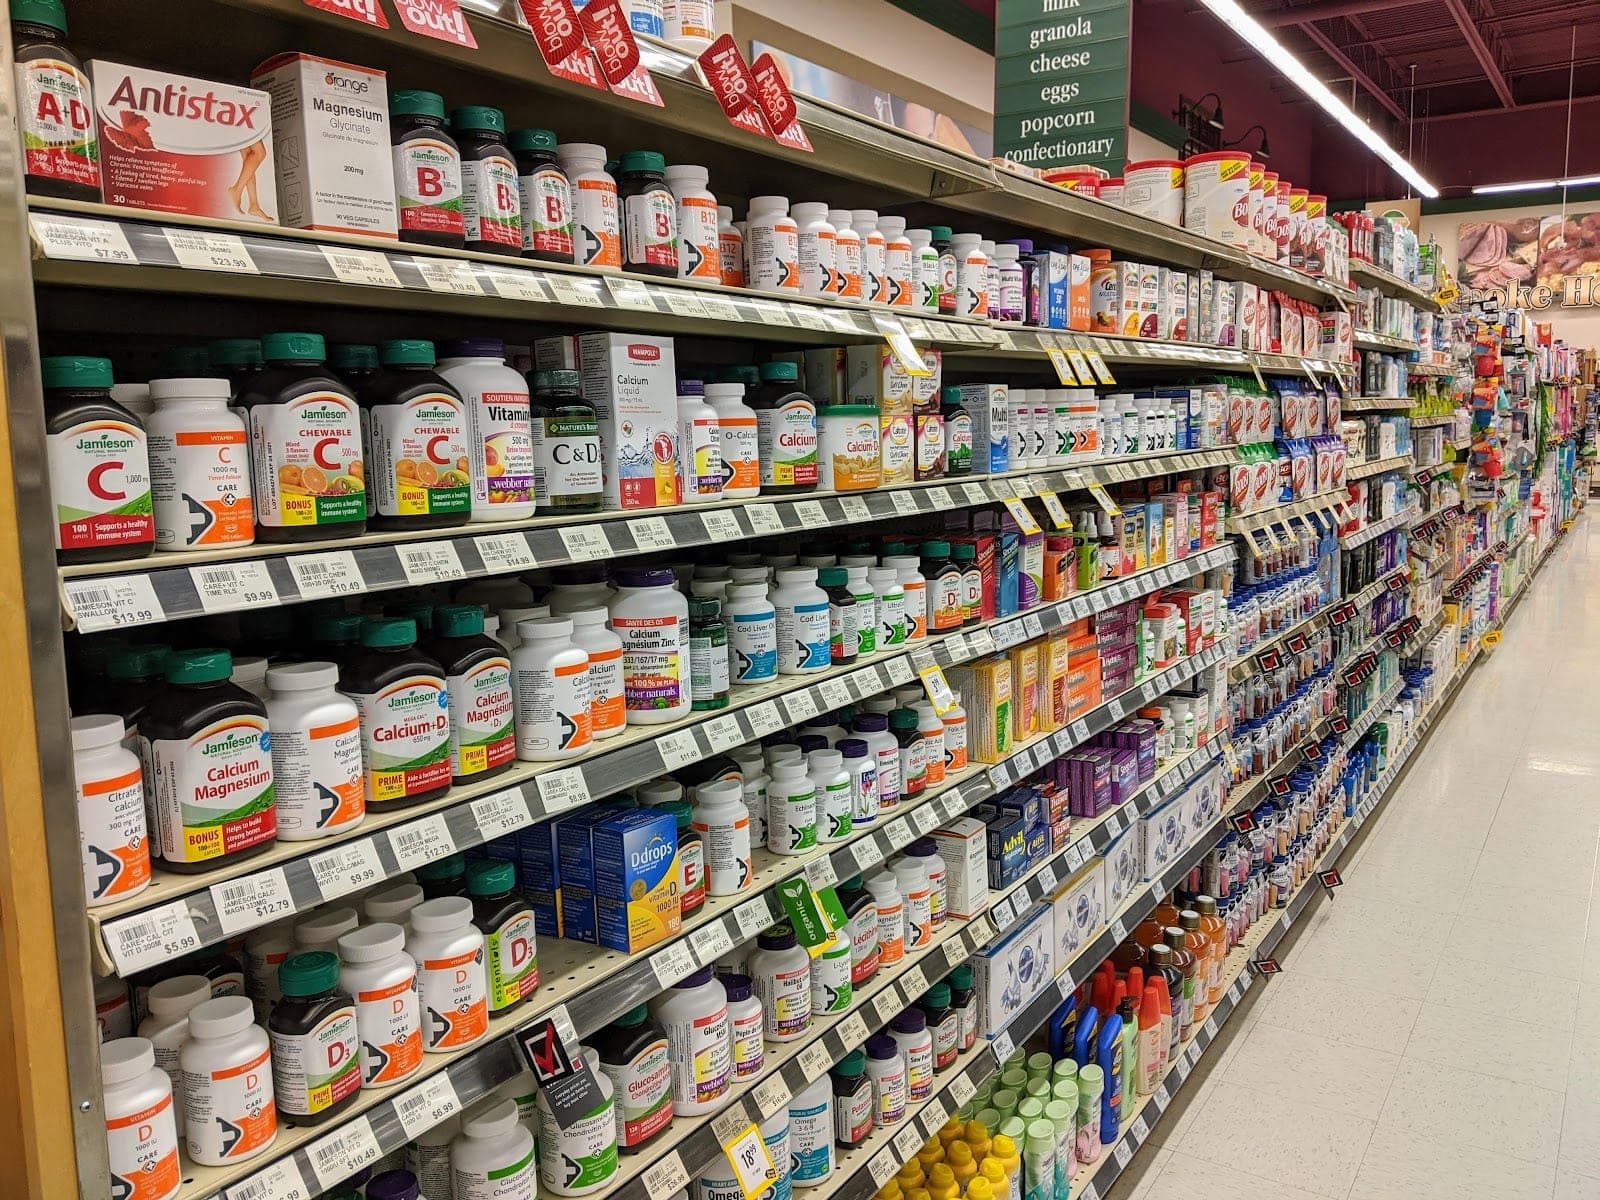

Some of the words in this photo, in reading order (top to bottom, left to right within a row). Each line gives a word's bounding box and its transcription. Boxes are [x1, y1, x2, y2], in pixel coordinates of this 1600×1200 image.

[407, 8, 466, 43] out!
[535, 5, 562, 53] blow
[592, 3, 628, 60] out!
[1030, 17, 1092, 49] granola
[595, 26, 622, 75] blow
[1030, 52, 1090, 74] cheese
[712, 47, 748, 95] out!
[716, 70, 740, 110] blow
[756, 66, 789, 112] out!
[1041, 82, 1080, 104] eggs
[108, 75, 256, 130] Antistax
[762, 88, 782, 126] blow
[313, 98, 383, 124] Magnesium
[330, 118, 371, 135] Glycinate
[1020, 110, 1095, 138] popcorn
[1004, 138, 1114, 162] confectionary
[411, 152, 450, 162] Jamieson
[113, 194, 126, 204] 30
[44, 232, 86, 242] JAMIESON
[50, 238, 72, 246] PLUS
[95, 248, 129, 260] $7.99
[211, 256, 246, 268] $23.99
[633, 349, 657, 357] WAMPOLE
[618, 374, 649, 386] Calcium
[618, 386, 640, 395] Liquid
[486, 394, 512, 402] SOUTIEN
[301, 408, 346, 420] Jamieson
[416, 410, 456, 419] Jamieson
[992, 408, 1008, 422] Multi
[299, 429, 352, 437] CHEWABLE
[414, 427, 460, 435] CHEWABLE
[75, 438, 134, 450] Jamieson
[210, 434, 234, 442] VITAMIN
[780, 434, 816, 446] Calcium
[218, 446, 232, 464] C
[313, 438, 341, 470] C
[342, 448, 352, 456] 500
[426, 436, 450, 465] C
[552, 444, 570, 465] C
[86, 461, 127, 501] C
[125, 474, 142, 484] 1,000
[494, 479, 523, 489] webber
[216, 483, 238, 492] CARE
[402, 492, 425, 501] BONUS
[286, 501, 312, 510] BONUS
[72, 524, 88, 534] 100
[95, 521, 117, 531] Supports
[123, 518, 148, 530] healthy
[96, 531, 120, 540] immune
[121, 530, 142, 540] system
[506, 556, 530, 566] $14.99
[206, 588, 222, 596] TIME
[330, 582, 360, 594] $10.49
[244, 590, 273, 602] $9.99
[74, 602, 113, 612] JAMIESON
[114, 600, 126, 608] VIT
[78, 608, 118, 619] SWALLOW
[112, 610, 153, 625] $13.99
[644, 618, 654, 626] DES
[753, 624, 768, 632] Liver
[629, 629, 660, 639] Calcium
[622, 640, 660, 650] agnésium
[661, 638, 676, 648] Zinc
[473, 674, 508, 689] Jamieson
[476, 690, 509, 708] Calcium
[646, 687, 676, 698] naturals
[388, 692, 436, 708] Jamieson
[202, 734, 258, 756] Jamieson
[465, 749, 484, 760] PRIME
[680, 750, 698, 761] $11.49
[206, 759, 260, 782] Calcium
[194, 770, 270, 801] Magnesium
[378, 775, 403, 786] PRIME
[108, 790, 136, 803] Citrate
[226, 824, 242, 834] Helps
[242, 822, 248, 830] to
[249, 816, 262, 828] build
[500, 814, 525, 828] $12.79
[124, 826, 142, 837] CARE
[189, 830, 220, 846] BONUS
[226, 831, 244, 842] strong
[245, 827, 261, 836] bones
[1002, 831, 1024, 854] Advil
[424, 843, 450, 860] $12.79
[631, 842, 673, 868] Ddrops
[350, 869, 374, 884] $9.99
[224, 894, 256, 909] JAMIESON
[257, 889, 275, 899] CALC
[224, 906, 244, 916] MAGN
[256, 900, 290, 917] $12.79
[656, 901, 672, 912] 1000
[668, 917, 680, 928] 180
[796, 900, 816, 942] organic
[120, 939, 144, 950] CARE+
[146, 934, 160, 942] CAL
[162, 927, 174, 936] CIT
[164, 936, 195, 954] $5.99
[123, 950, 136, 958] VIT
[490, 938, 502, 1002] essentials
[454, 994, 471, 1004] CARE
[393, 1000, 404, 1014] D
[391, 1025, 409, 1036] CARE
[246, 1074, 258, 1090] D
[245, 1098, 262, 1110] CARE
[130, 1108, 156, 1122] VITAMIN
[432, 1102, 454, 1120] $6.99
[138, 1124, 152, 1142] D
[564, 1124, 601, 1138] Chondroitin
[137, 1150, 158, 1163] CARE
[347, 1149, 376, 1170] $10.49
